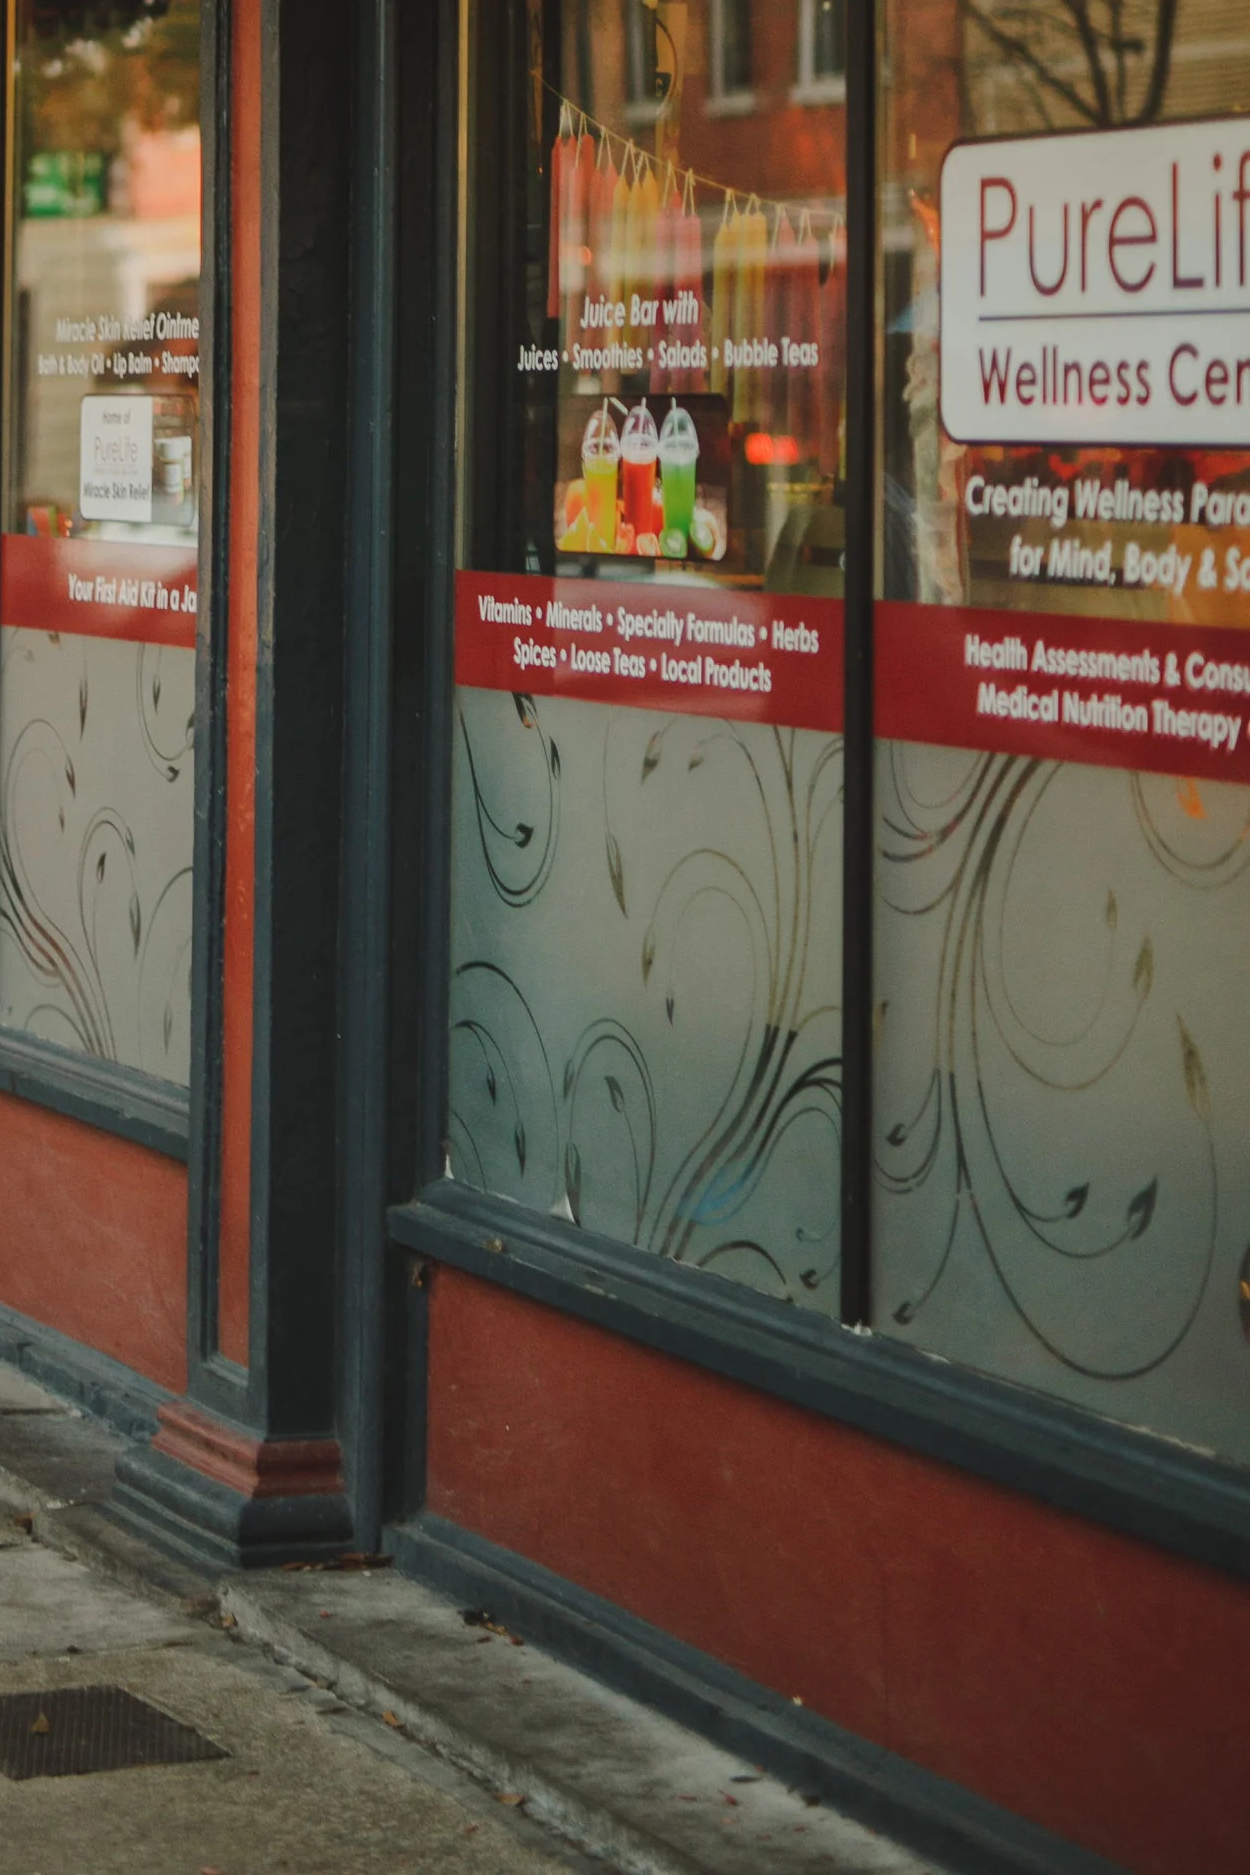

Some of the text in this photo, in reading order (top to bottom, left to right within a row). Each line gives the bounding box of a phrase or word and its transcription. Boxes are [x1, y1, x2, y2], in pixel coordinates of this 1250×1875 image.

[56, 311, 199, 342] Miracle Skin Relief Ointme
[581, 290, 698, 329] Juice Bar with
[91, 352, 104, 375] Oil
[113, 352, 127, 379] Lip
[128, 351, 152, 374] Balm
[518, 336, 818, 371] Juices Smoothies Salads Bubble Teas
[978, 344, 1152, 406] Wellness
[965, 475, 1250, 528] Creating Wellness Para
[68, 573, 94, 602] Your
[94, 576, 116, 604] First
[118, 578, 139, 607] Aid
[140, 580, 156, 609] Kit
[156, 580, 168, 610] in
[170, 588, 180, 611] a
[1009, 535, 1043, 575] for
[1048, 538, 1116, 585] Mind,
[1123, 542, 1192, 597] Body
[1198, 547, 1217, 589] &
[478, 595, 819, 654] Vitamins Minerals Specialty Formulas Herbs
[513, 636, 772, 693] Spices Loose Teas Local Products
[965, 633, 1028, 672] Health
[1031, 639, 1161, 685] Assessments
[1165, 652, 1181, 687] &
[976, 681, 1242, 753] Medical Nutrition Therapy
